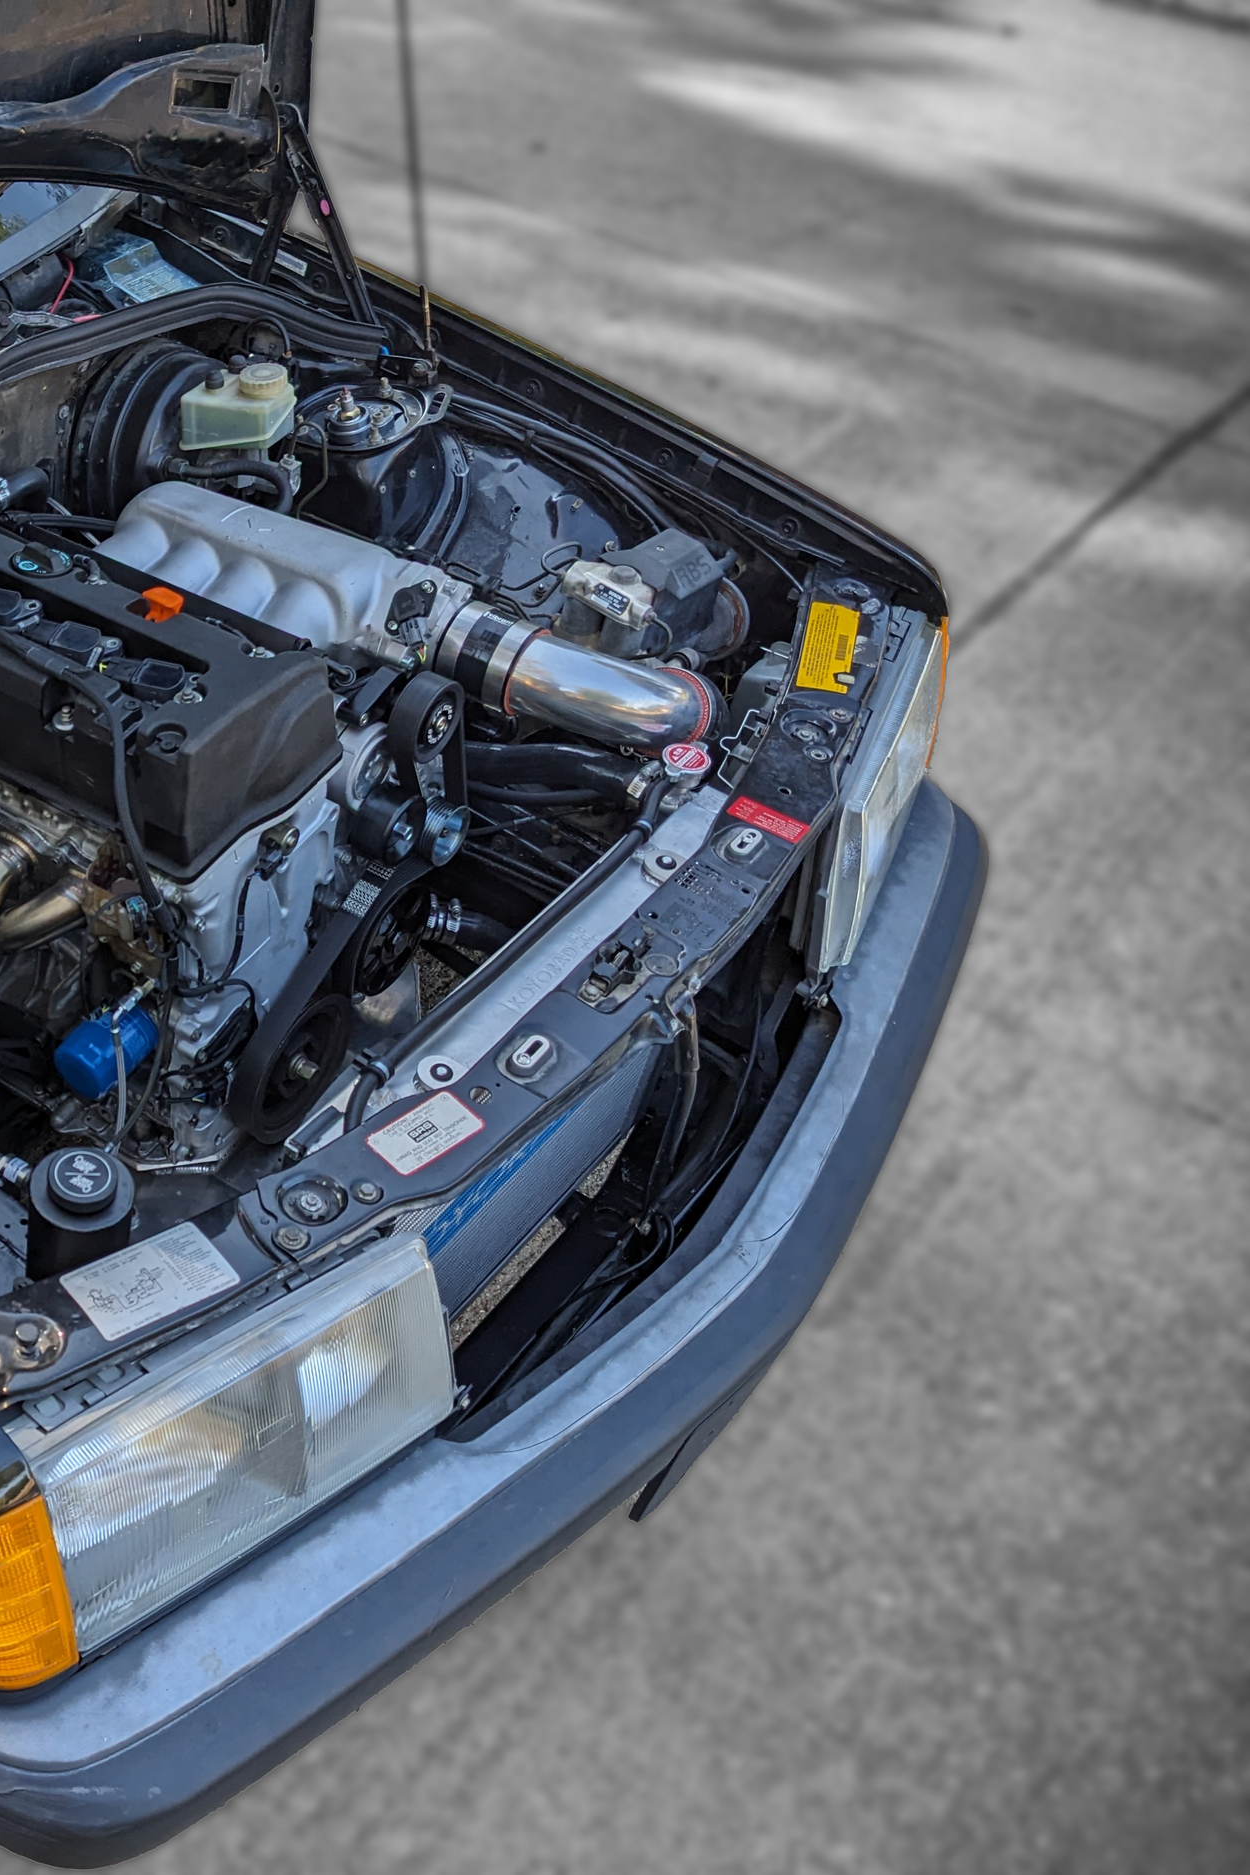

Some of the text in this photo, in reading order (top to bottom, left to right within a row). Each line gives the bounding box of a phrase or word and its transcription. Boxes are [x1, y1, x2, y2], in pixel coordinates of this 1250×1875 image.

[675, 555, 711, 588] ABS
[382, 1117, 410, 1136] CAUTION!
[408, 1121, 433, 1139] SRS
